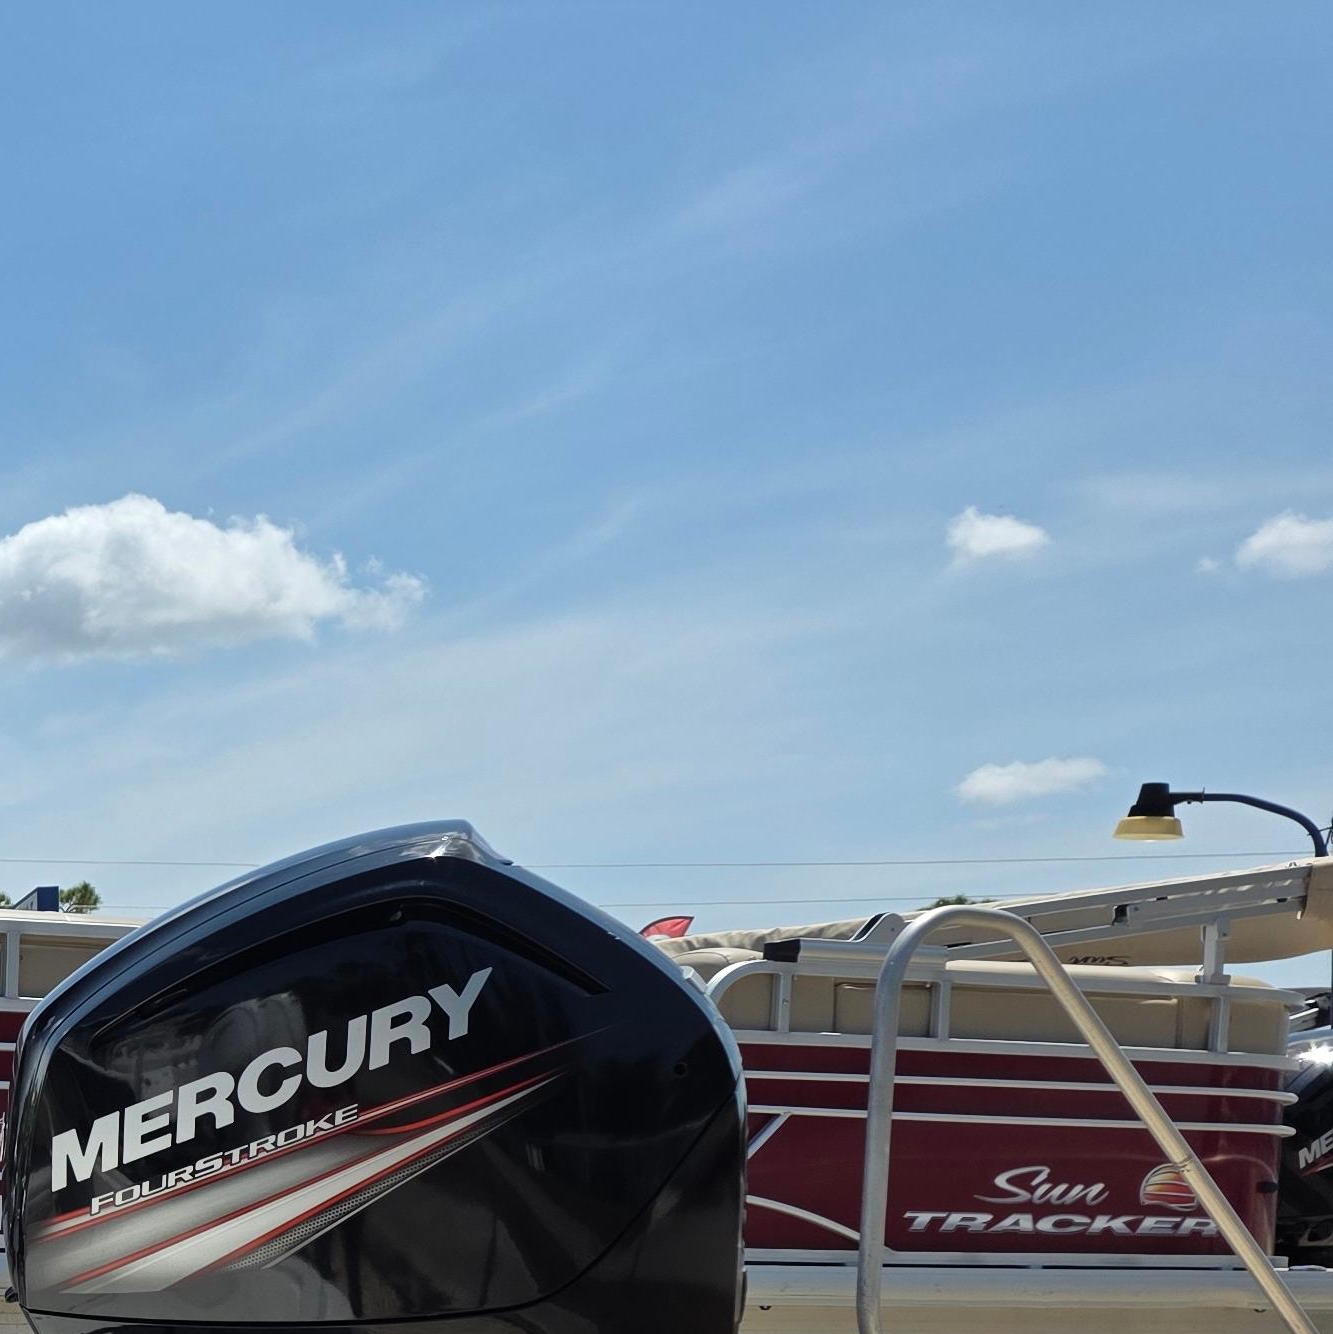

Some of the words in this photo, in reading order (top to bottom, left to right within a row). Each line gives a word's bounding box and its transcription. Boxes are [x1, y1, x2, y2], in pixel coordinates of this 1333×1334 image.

[51, 966, 493, 1192] MERCURY
[89, 1103, 359, 1215] FOURSTROKE
[973, 1166, 1110, 1206] Sun
[903, 1210, 1223, 1238] TRACKER
